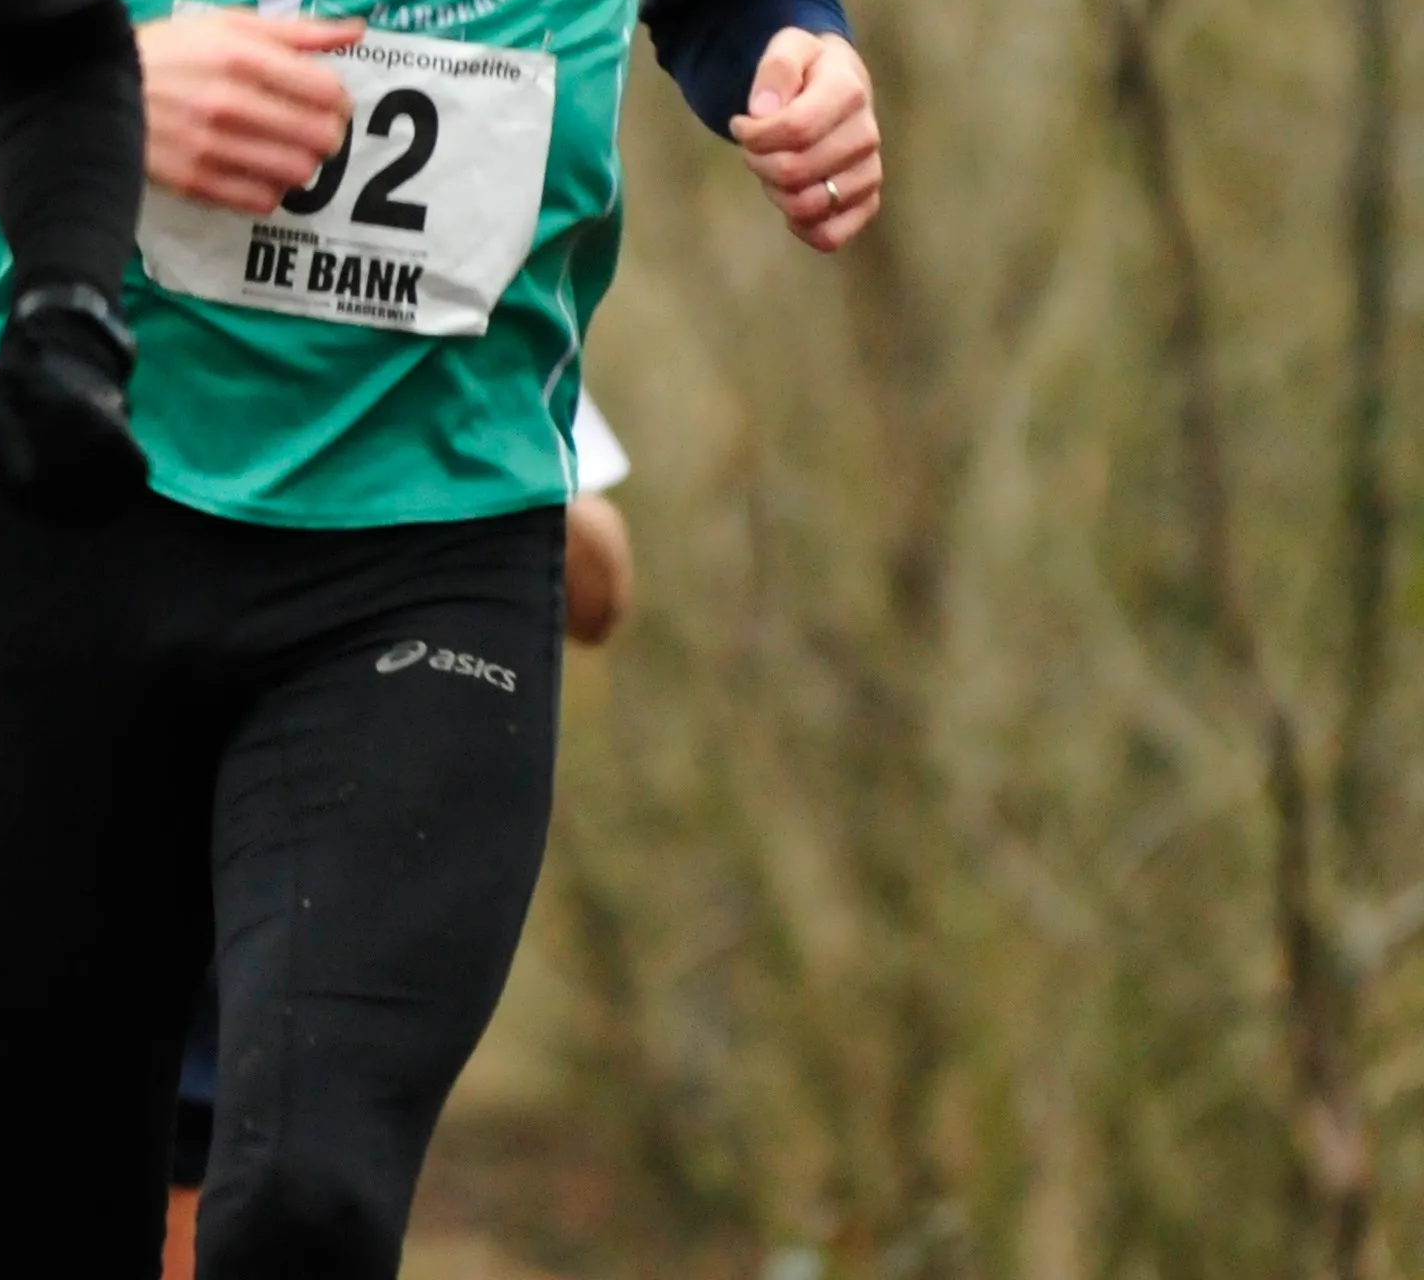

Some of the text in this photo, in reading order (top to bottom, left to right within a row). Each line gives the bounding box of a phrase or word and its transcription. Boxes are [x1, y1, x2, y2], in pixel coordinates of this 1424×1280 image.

[322, 43, 522, 82] sloopcompetitie
[244, 240, 424, 306] DE BANK
[429, 648, 517, 693] asics
